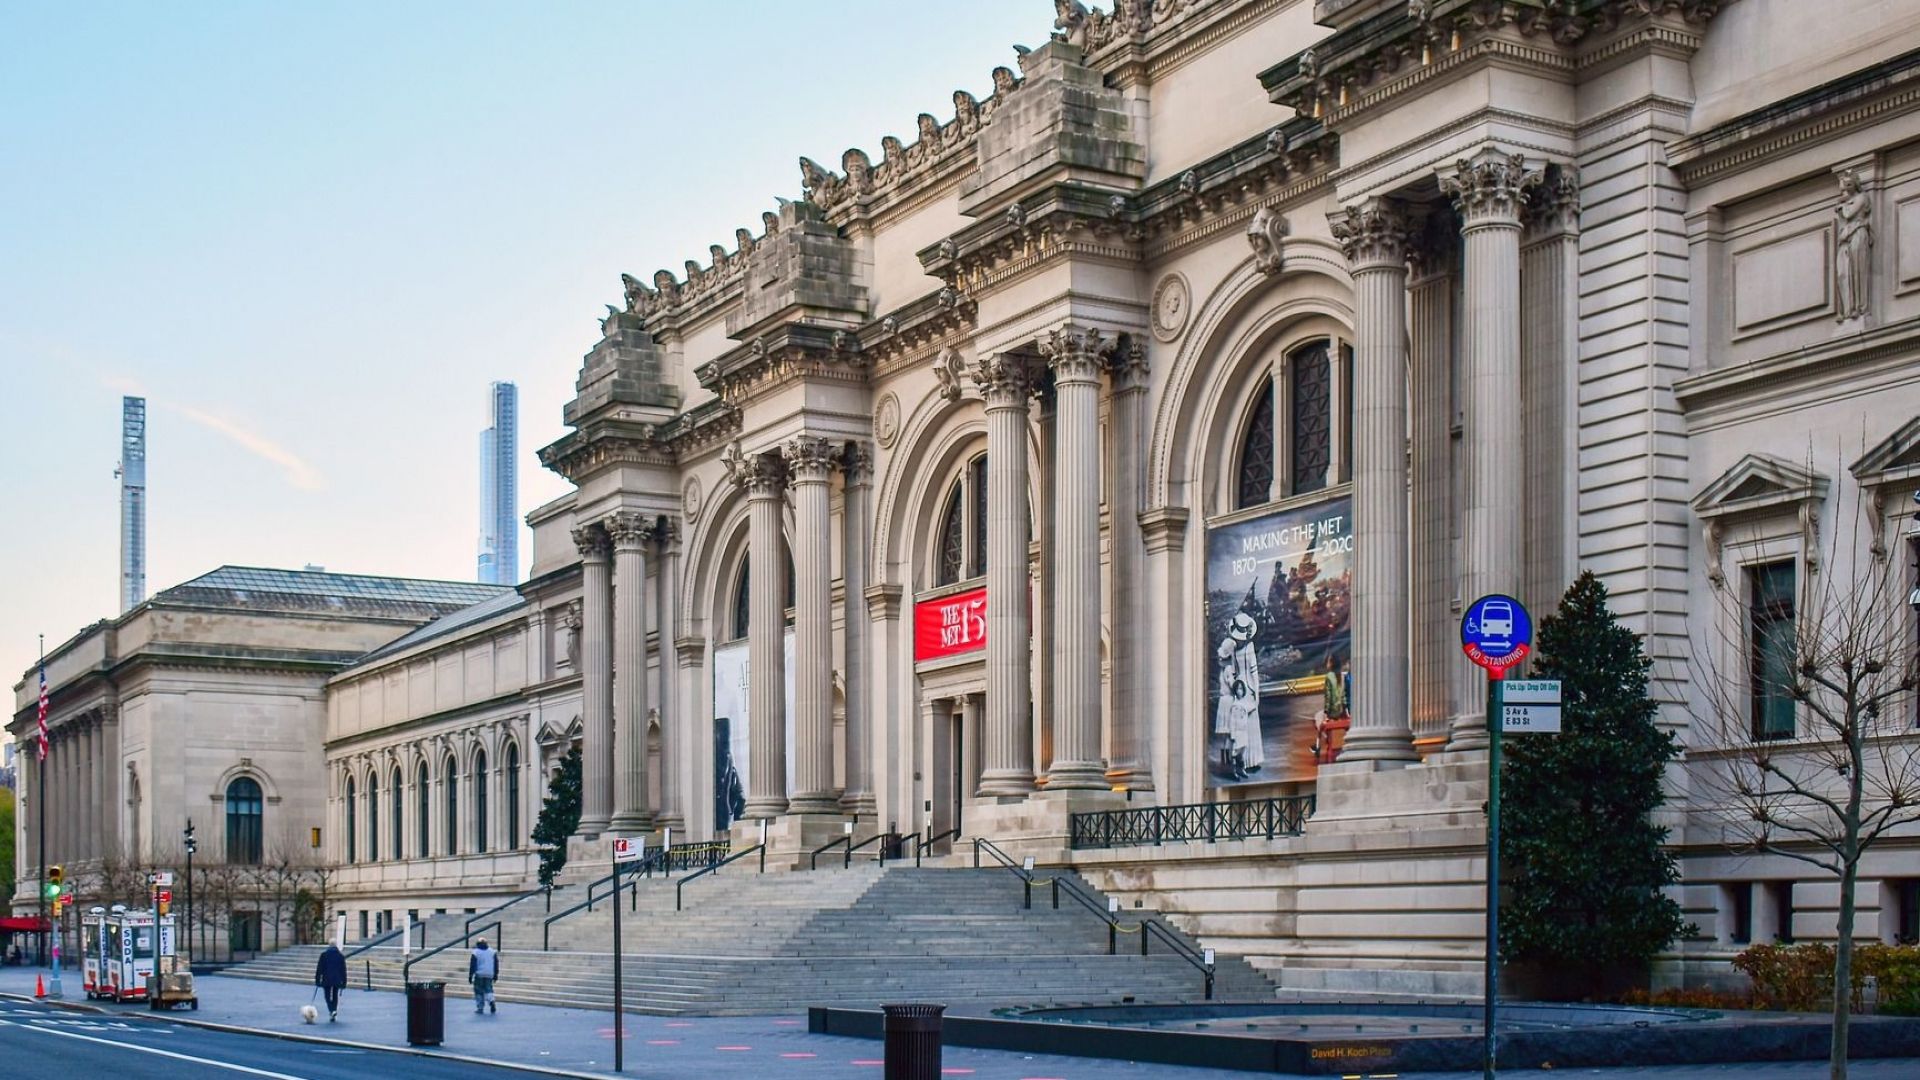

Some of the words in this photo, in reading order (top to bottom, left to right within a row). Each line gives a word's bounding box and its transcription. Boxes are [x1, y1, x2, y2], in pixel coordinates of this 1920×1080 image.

[1242, 529, 1289, 554] MAKING
[1291, 523, 1315, 543] THE
[1317, 516, 1343, 537] MET
[1232, 557, 1256, 576] 1870
[940, 603, 961, 627] THE
[940, 624, 962, 649] MET
[1468, 647, 1482, 660] NO
[1482, 647, 1524, 666] STANDING
[1506, 707, 1511, 715] 5
[1512, 707, 1521, 715] Av
[1506, 717, 1511, 725] E
[1522, 717, 1530, 725] St
[123, 929, 132, 964] SODA
[1311, 1047, 1336, 1058] David
[1347, 1047, 1369, 1057] Koch
